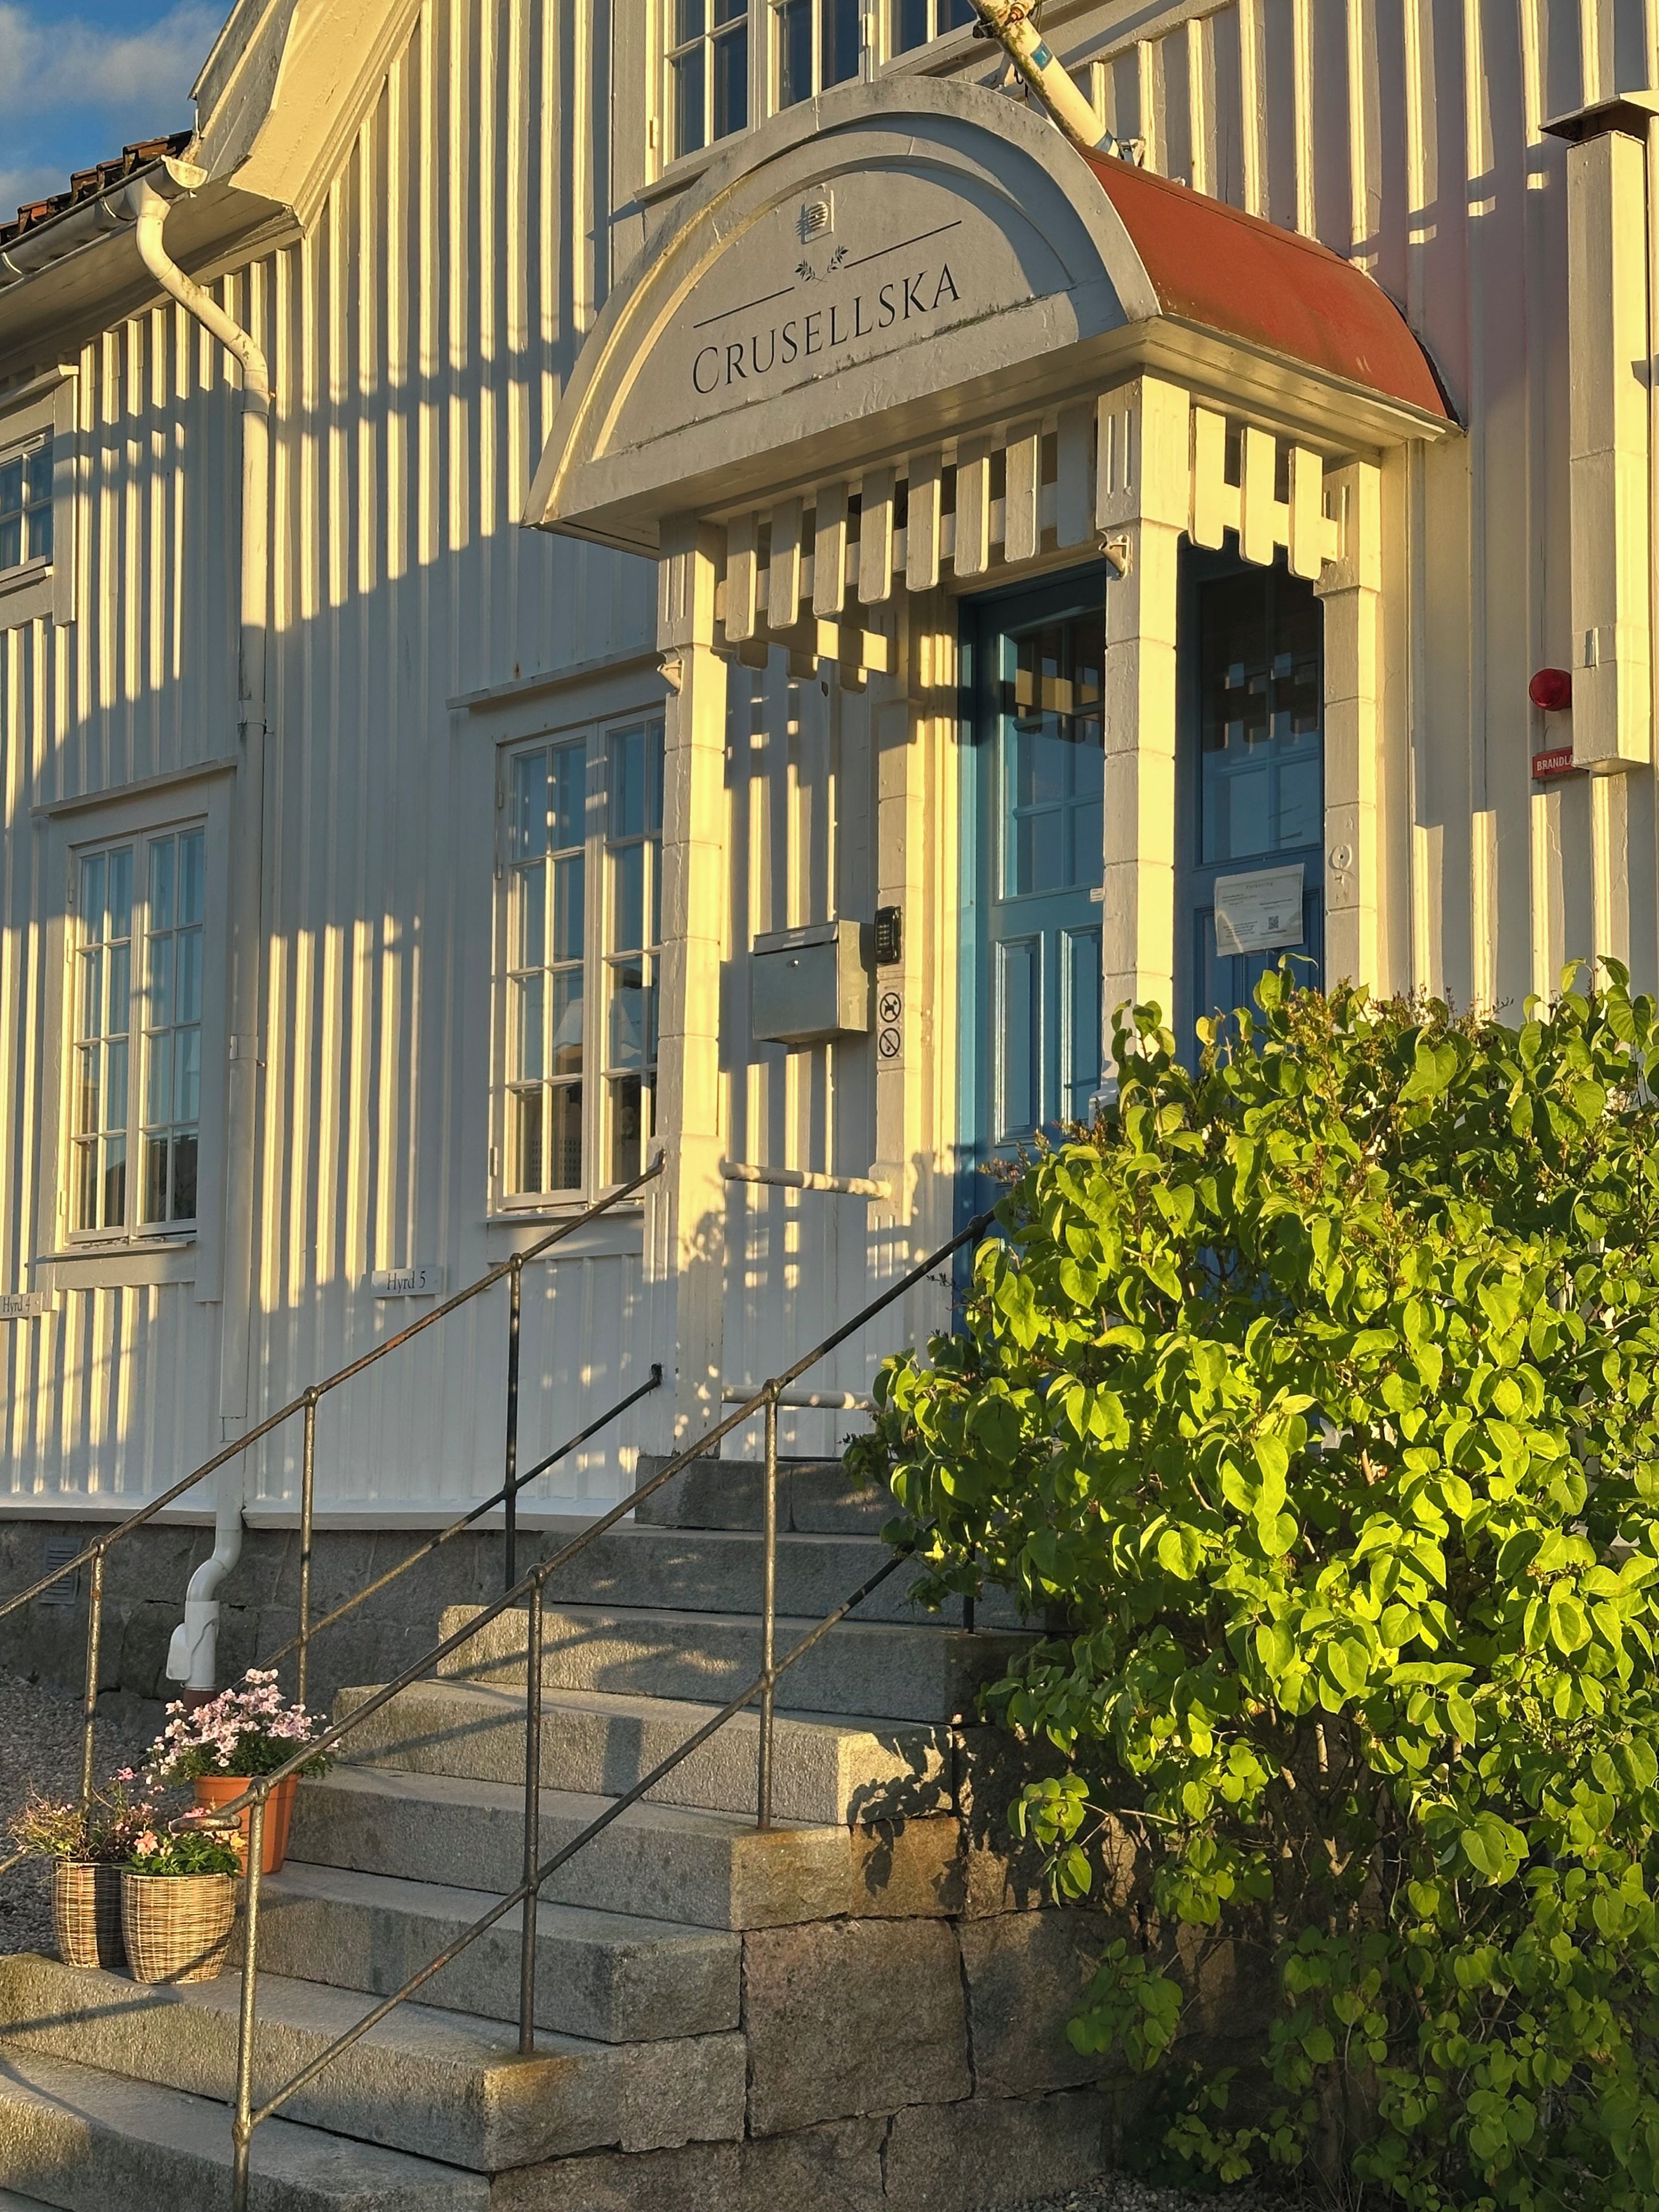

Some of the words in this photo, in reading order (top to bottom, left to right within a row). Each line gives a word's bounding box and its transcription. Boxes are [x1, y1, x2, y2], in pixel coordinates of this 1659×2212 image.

[692, 263, 961, 394] CRUSELLSKA
[387, 1271, 415, 1294] Hyrd
[419, 1270, 427, 1289] 5
[2, 1296, 23, 1316] Hyrd
[25, 1295, 31, 1312] 4
